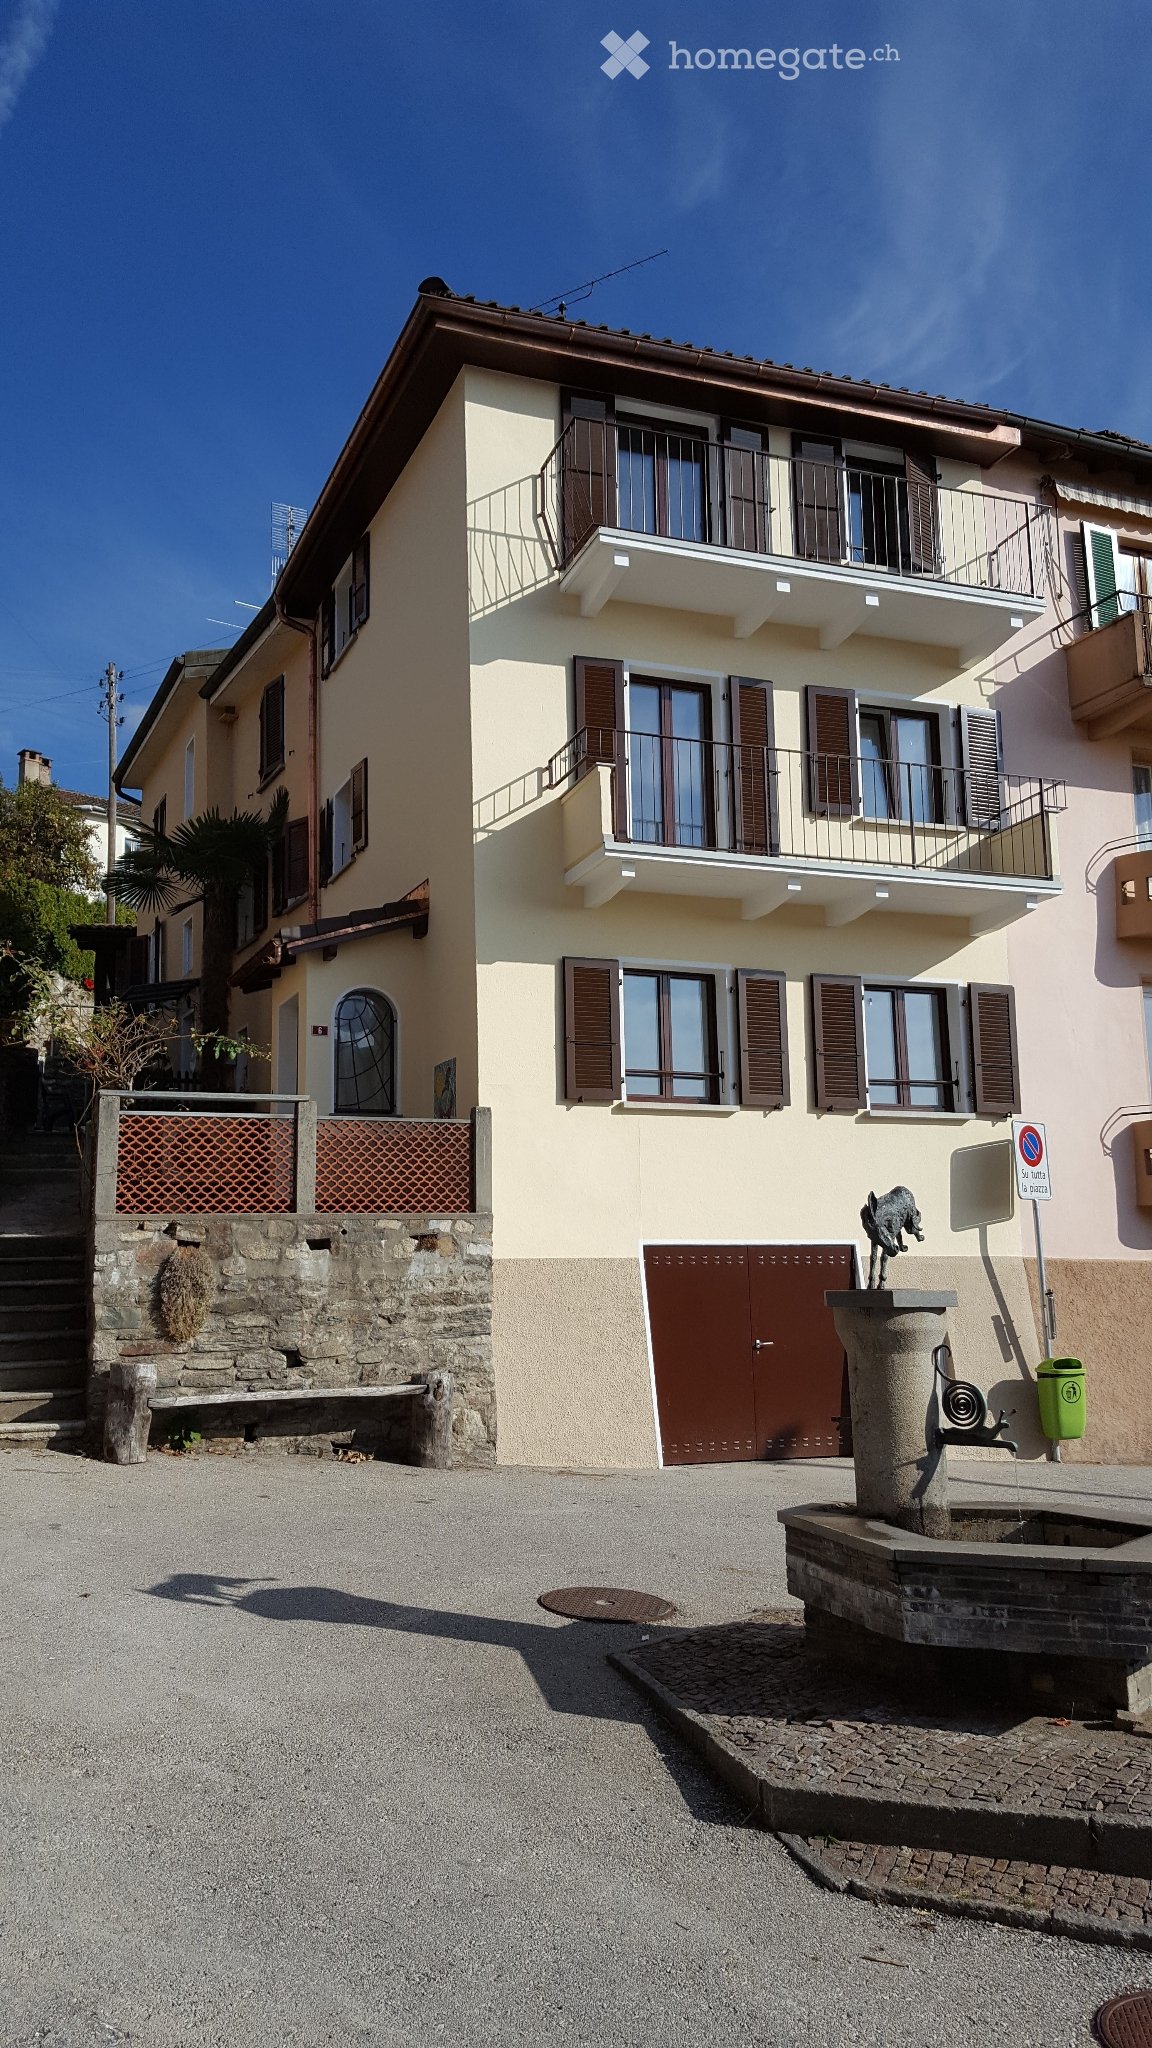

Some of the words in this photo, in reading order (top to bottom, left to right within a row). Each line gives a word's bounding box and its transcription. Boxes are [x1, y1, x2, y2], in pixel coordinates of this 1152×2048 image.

[317, 1026, 323, 1035] 6
[1021, 1168, 1029, 1179] Su
[1031, 1170, 1046, 1180] tutta
[1021, 1182, 1028, 1193] la
[1029, 1182, 1048, 1195] piazza
